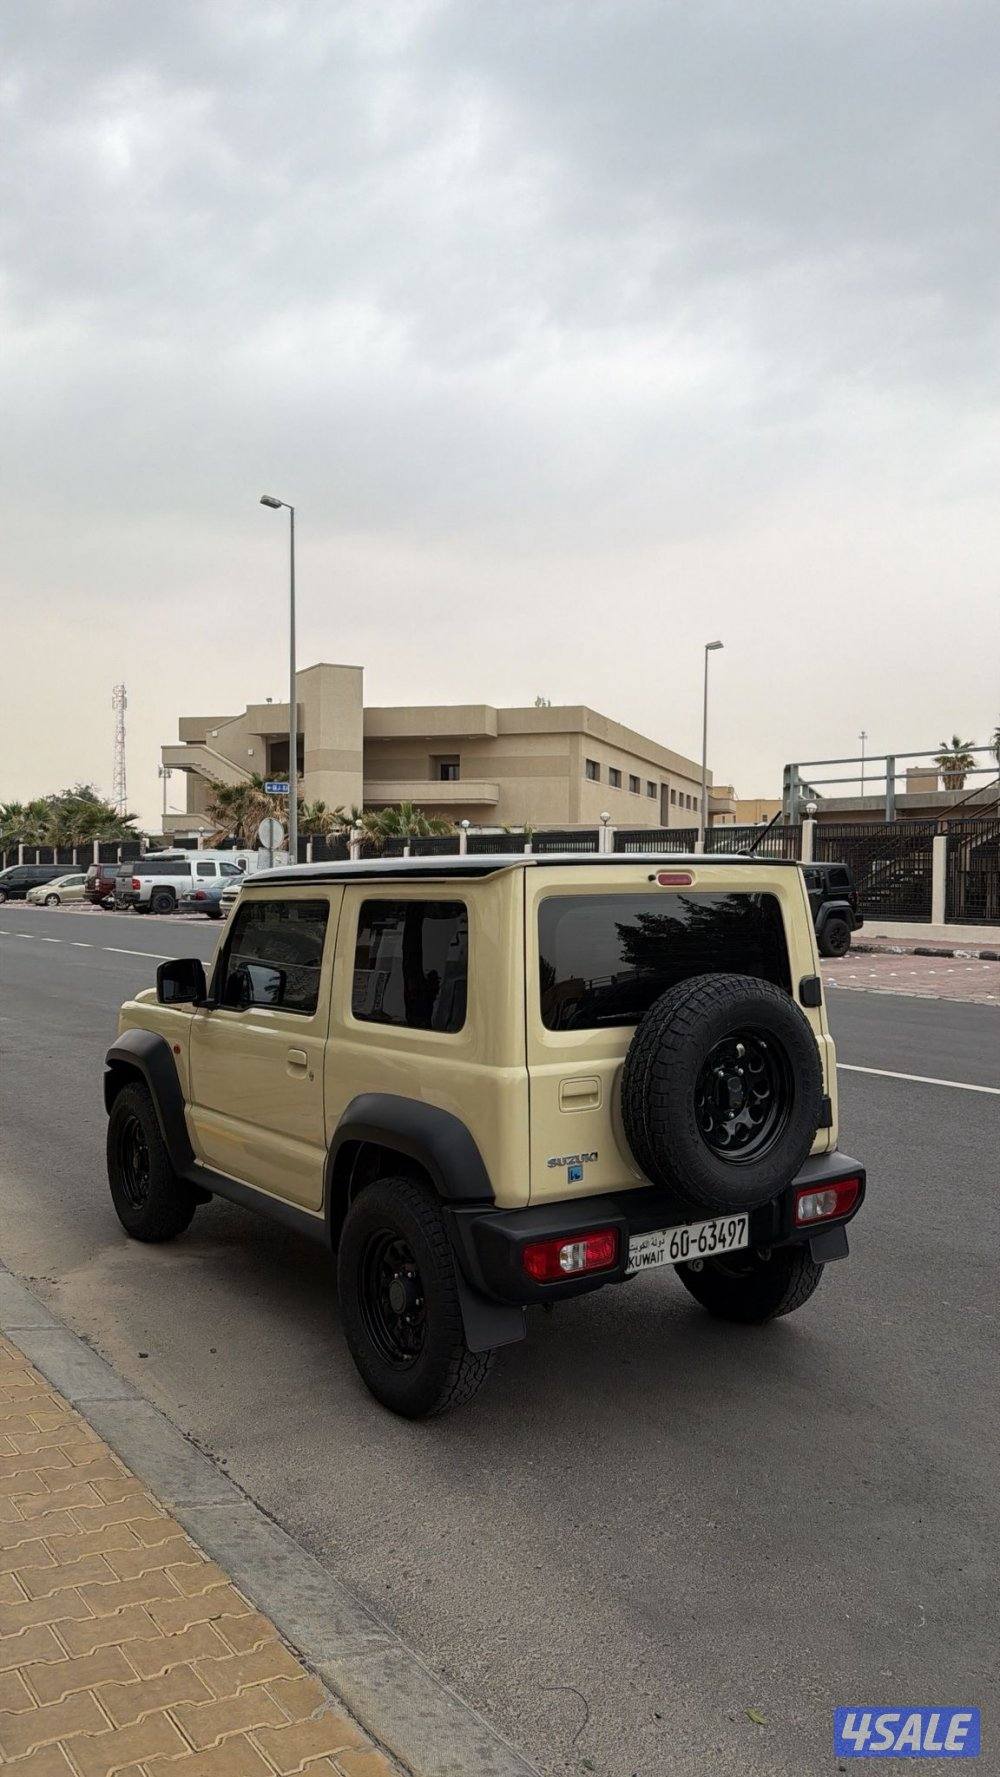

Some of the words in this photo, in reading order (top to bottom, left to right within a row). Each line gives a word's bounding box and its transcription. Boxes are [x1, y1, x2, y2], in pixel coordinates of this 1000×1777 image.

[547, 1152, 598, 1168] SUZUKI
[669, 1218, 746, 1259] 60-63497
[628, 1250, 665, 1268] KUWAIT
